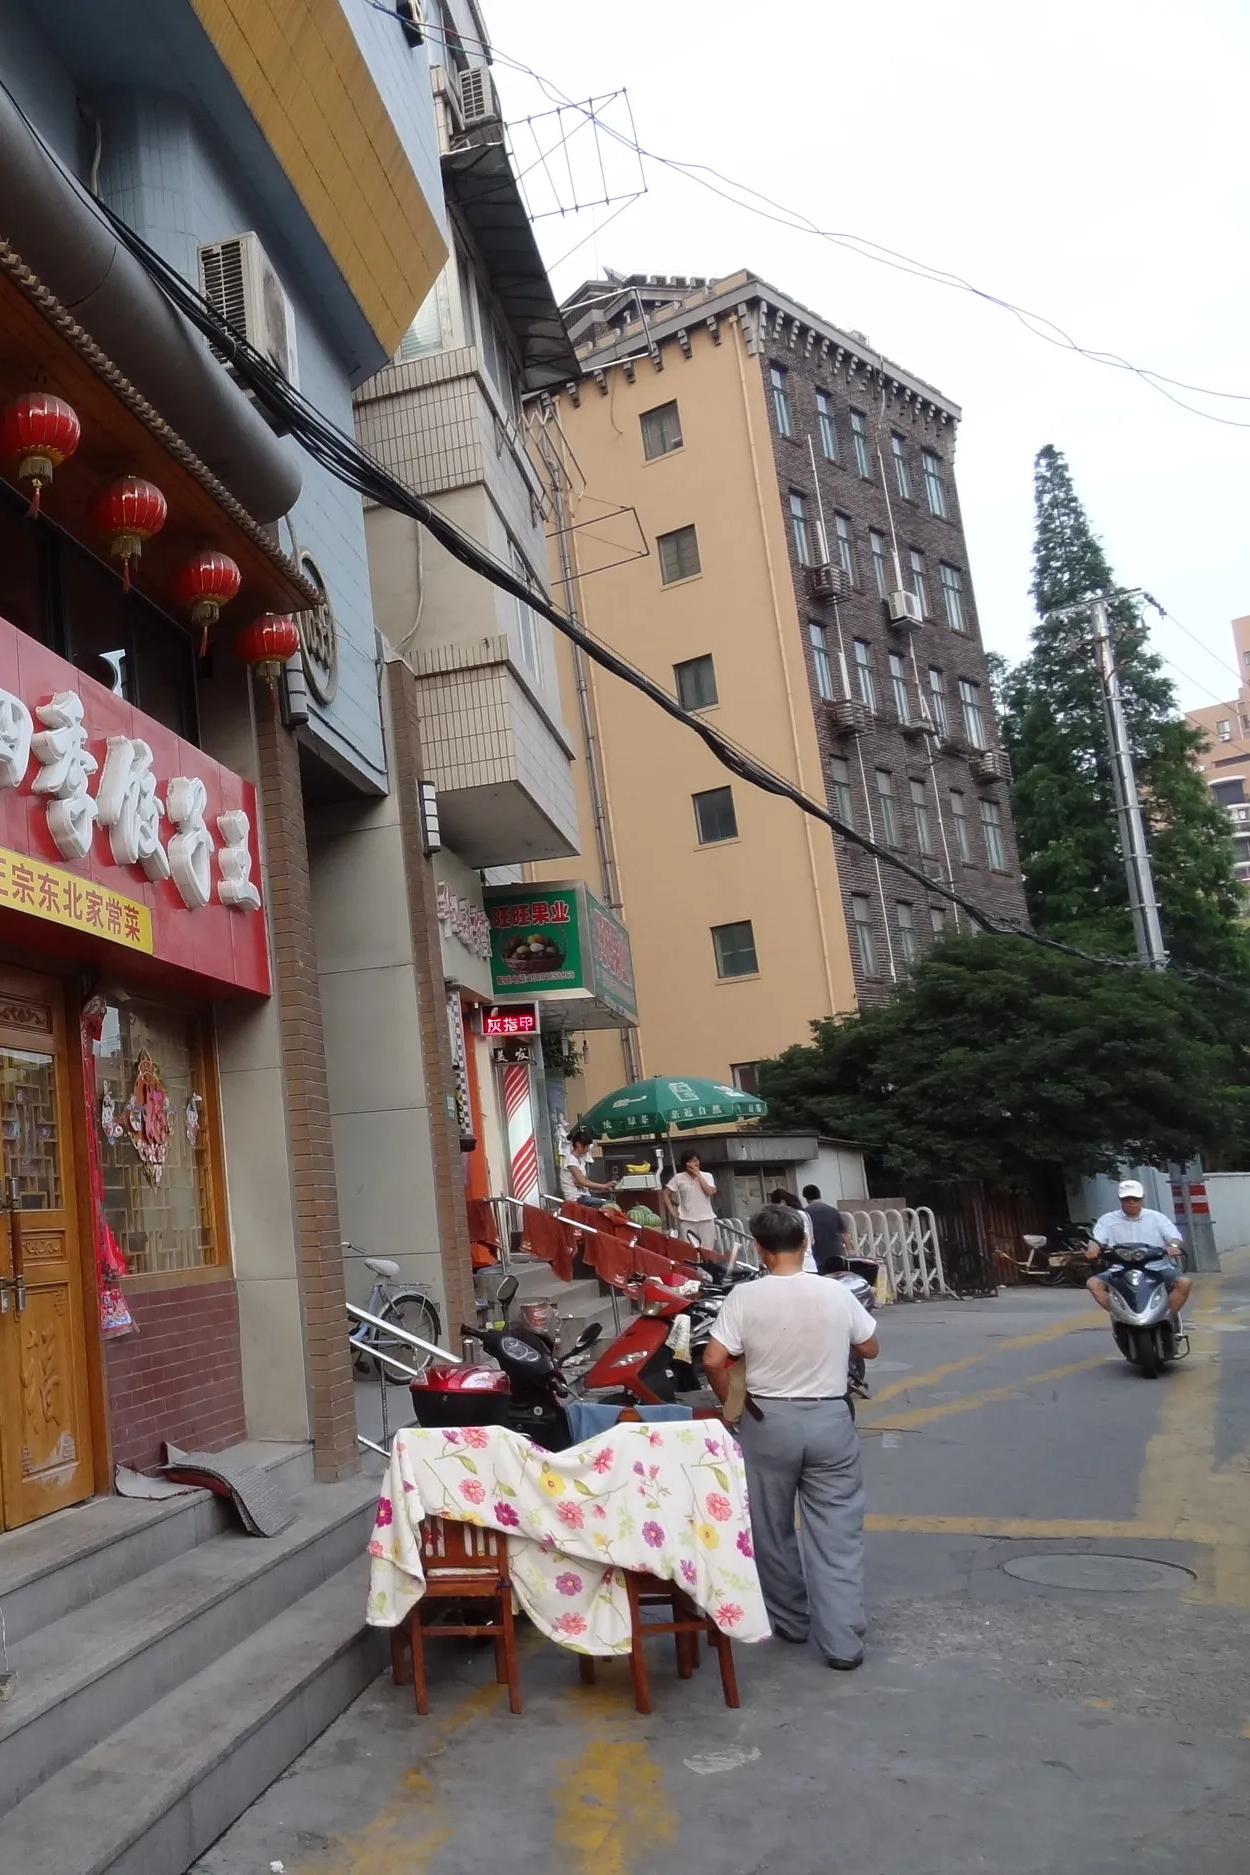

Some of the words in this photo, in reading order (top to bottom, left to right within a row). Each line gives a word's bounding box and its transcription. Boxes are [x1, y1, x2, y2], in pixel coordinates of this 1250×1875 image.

[491, 900, 571, 929] 旺旺果业
[487, 1017, 533, 1033] 灰指甲
[495, 1047, 529, 1063] 美发
[670, 1103, 723, 1119] 亲近自然
